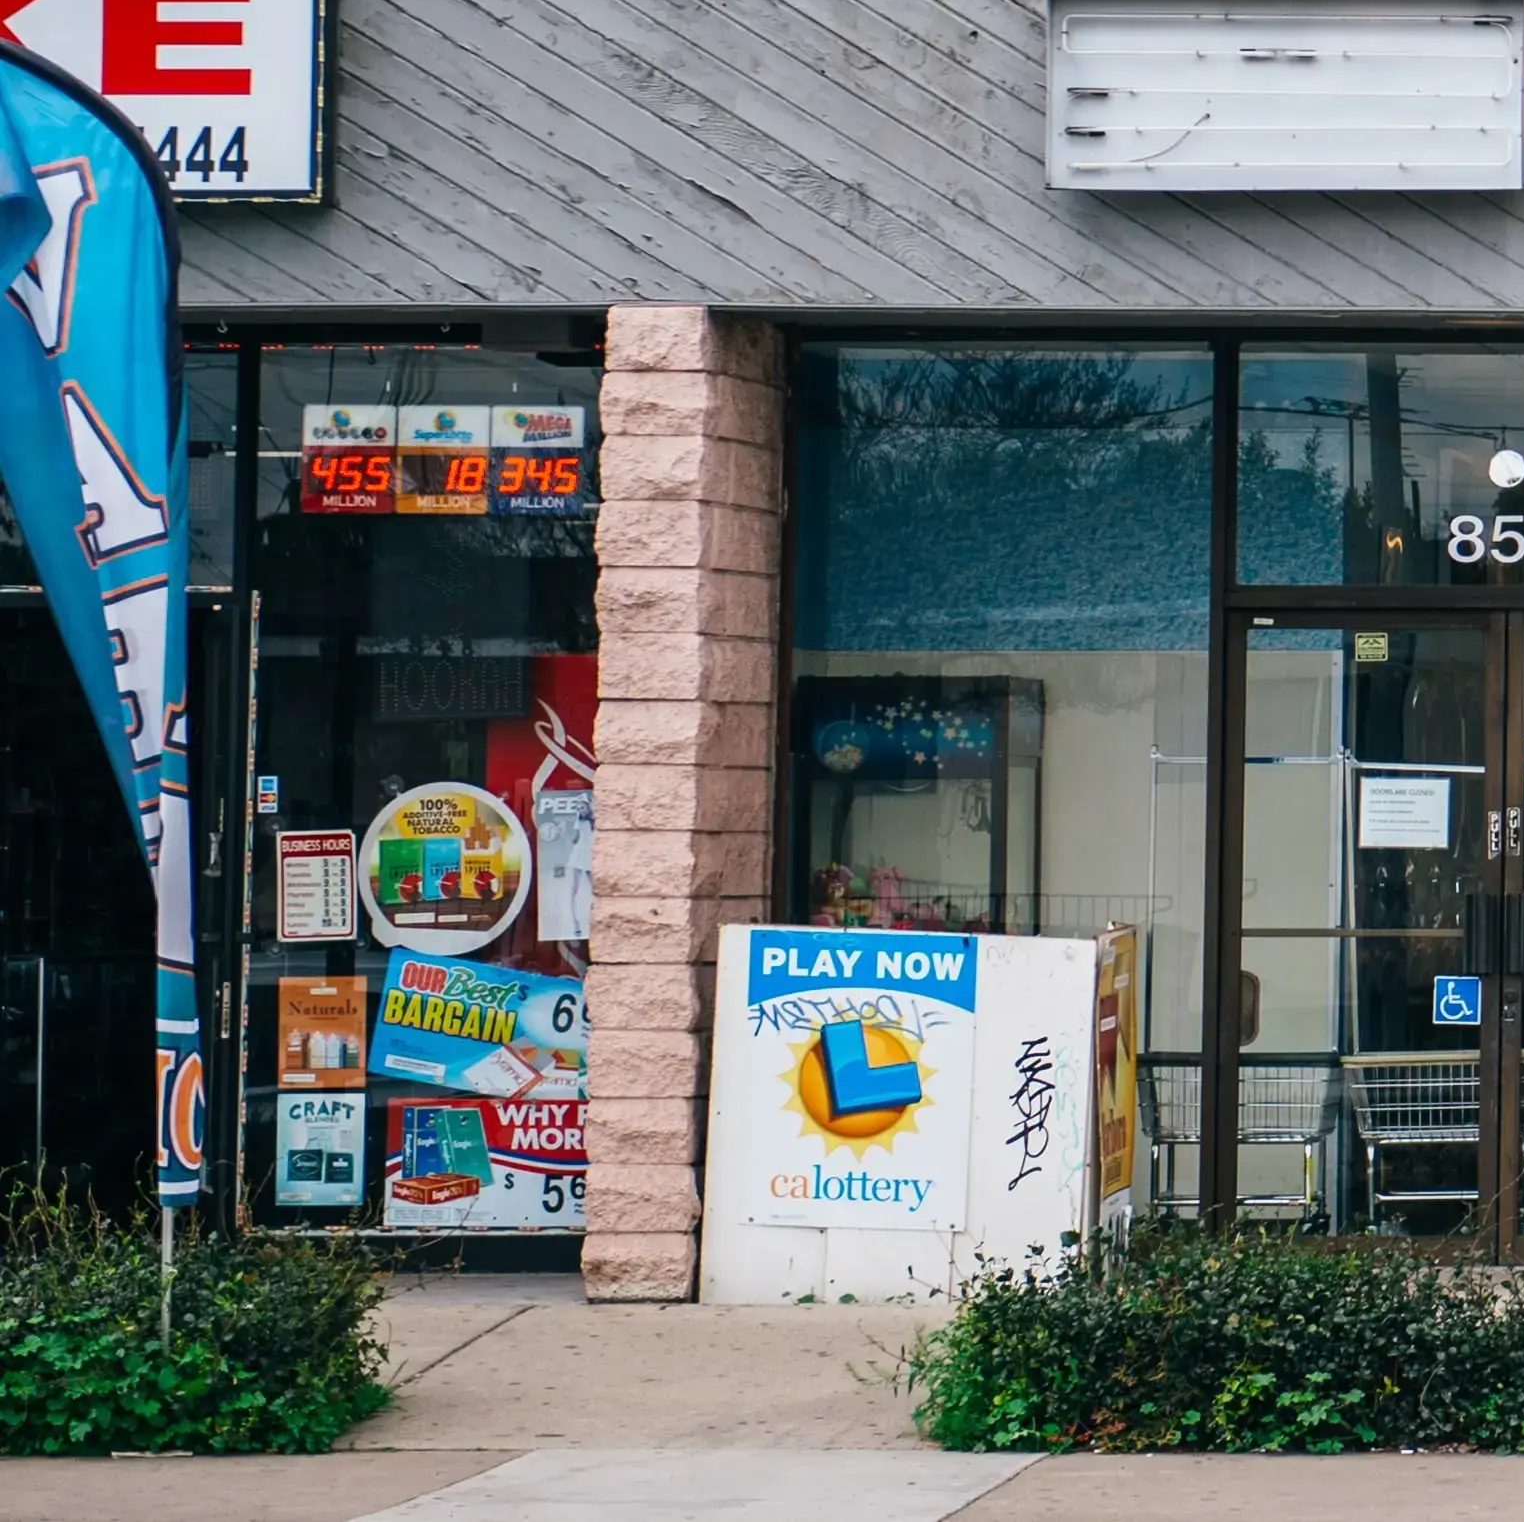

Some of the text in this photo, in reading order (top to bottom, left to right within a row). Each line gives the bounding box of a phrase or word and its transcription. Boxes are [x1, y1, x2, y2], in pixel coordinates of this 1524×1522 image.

[526, 414, 573, 432] MEGA
[311, 456, 392, 492] 455
[444, 456, 487, 495] 18
[498, 457, 580, 496] 345
[322, 494, 378, 507] MILLION
[416, 494, 472, 508] MILLION
[510, 495, 567, 510] MILLION
[402, 810, 468, 819] ADDITIVE-FREE
[419, 798, 458, 811] 100%
[407, 819, 455, 827] NATURAL
[412, 825, 461, 835] TOBACCO
[1491, 813, 1499, 852] PULL
[1508, 809, 1518, 848] PULL
[281, 838, 352, 853] BUSINESS HOURS
[762, 947, 863, 979] PLAY
[876, 950, 965, 981] NOW
[401, 962, 519, 1009] OUR Best
[287, 998, 359, 1016] Naturals
[382, 989, 518, 1045] BARGAIN
[288, 1099, 356, 1120] CRAFT
[497, 1104, 571, 1127] WHY
[769, 1163, 934, 1213] calottery
